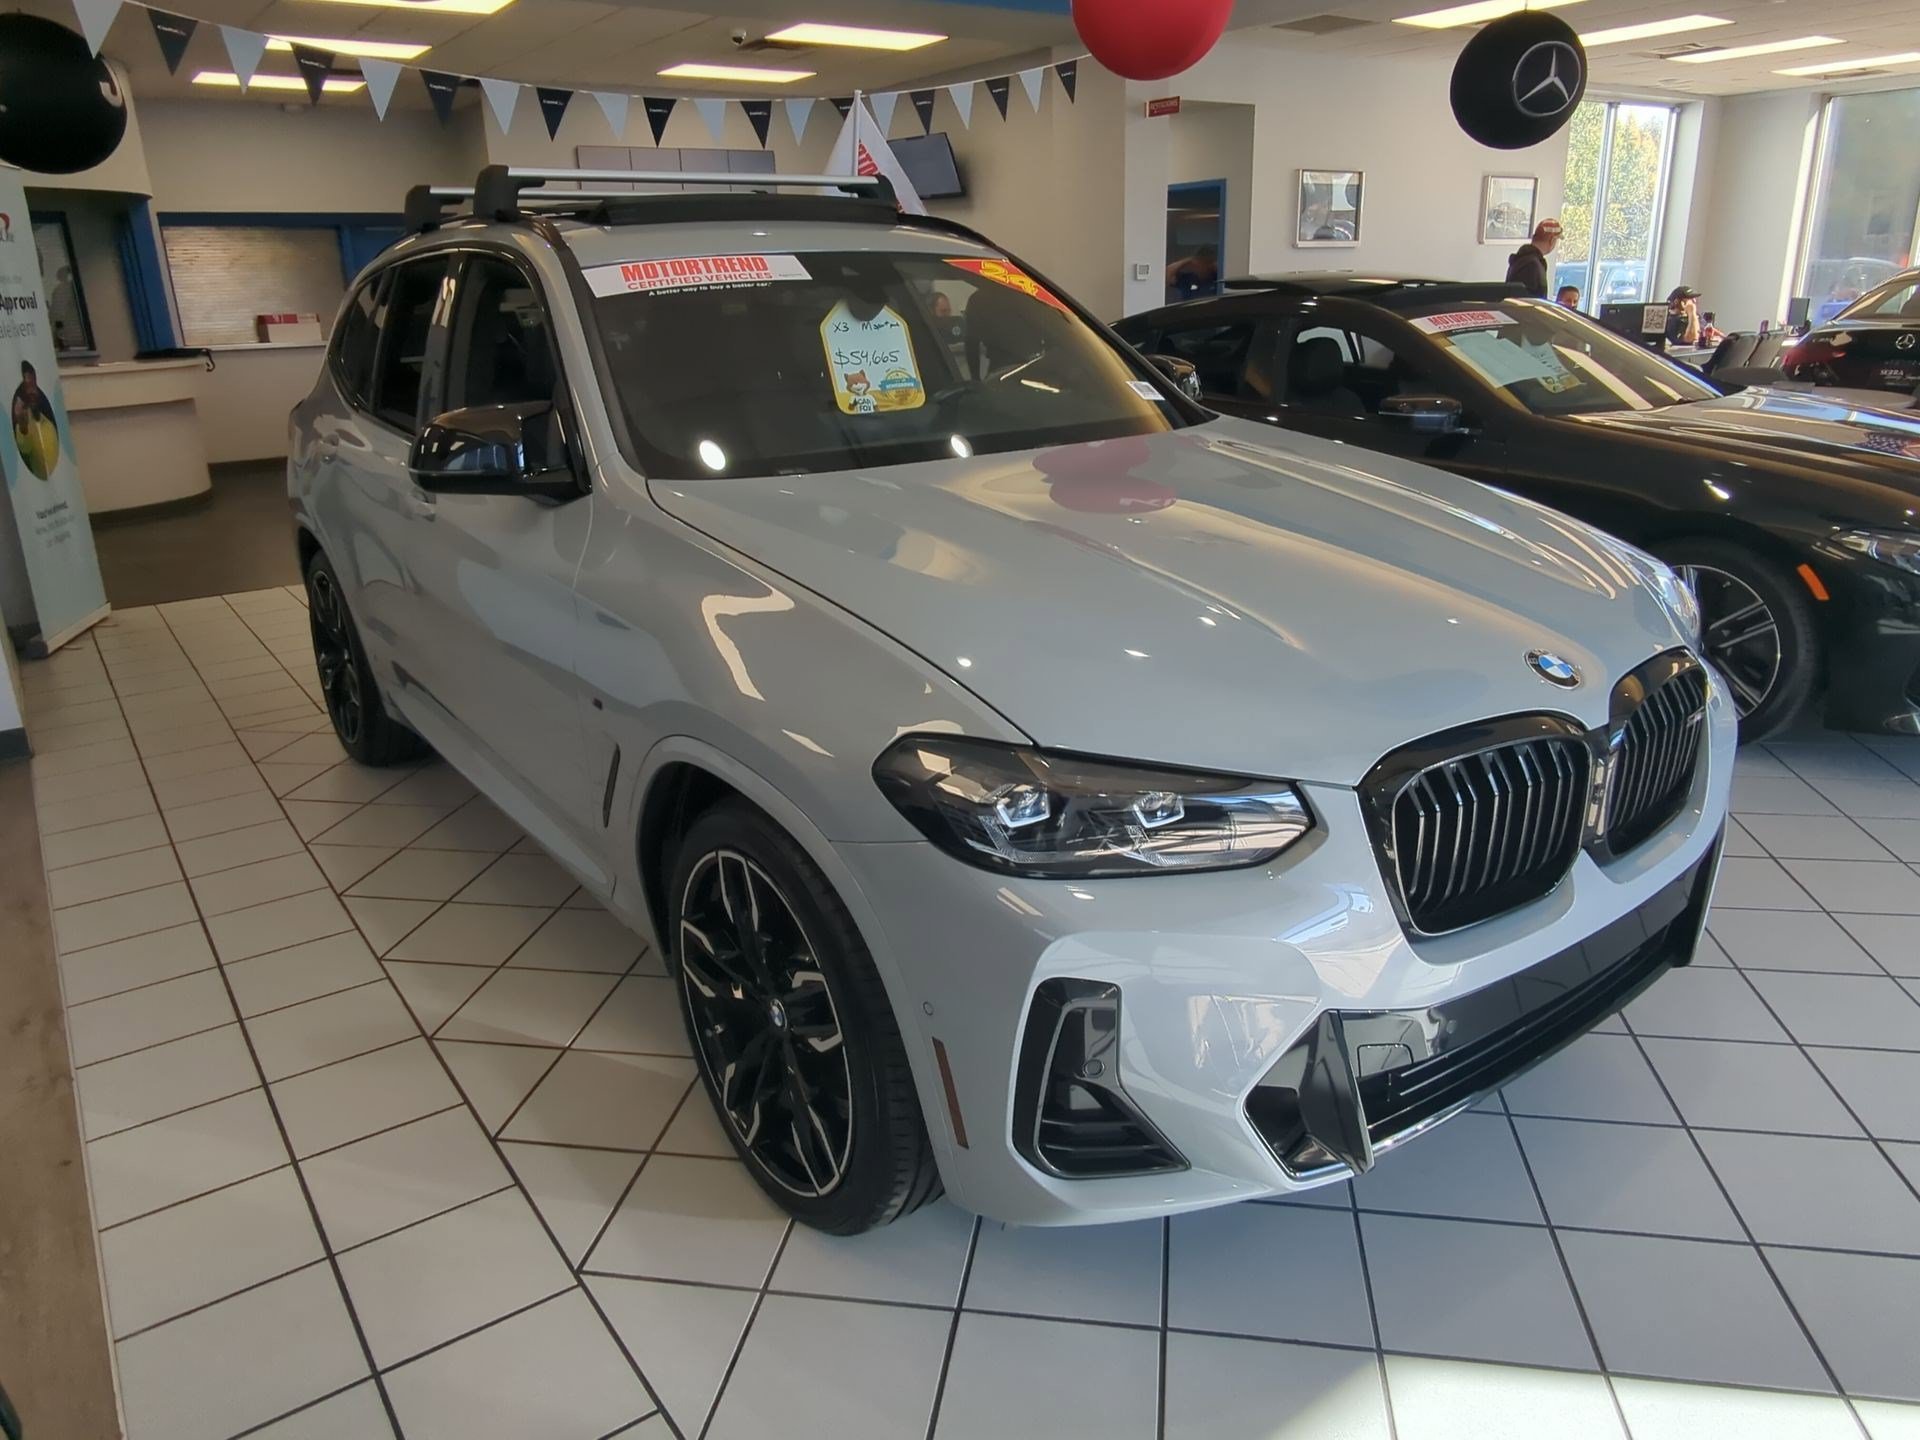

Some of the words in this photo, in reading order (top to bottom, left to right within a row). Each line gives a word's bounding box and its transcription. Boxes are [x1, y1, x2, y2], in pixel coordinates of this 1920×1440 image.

[620, 256, 769, 282] MOTORTREND
[627, 276, 703, 290] CERTIFIED
[705, 272, 773, 283] VEHICLES
[656, 288, 680, 296] better
[833, 321, 850, 333] X3
[833, 347, 900, 369] $54,665
